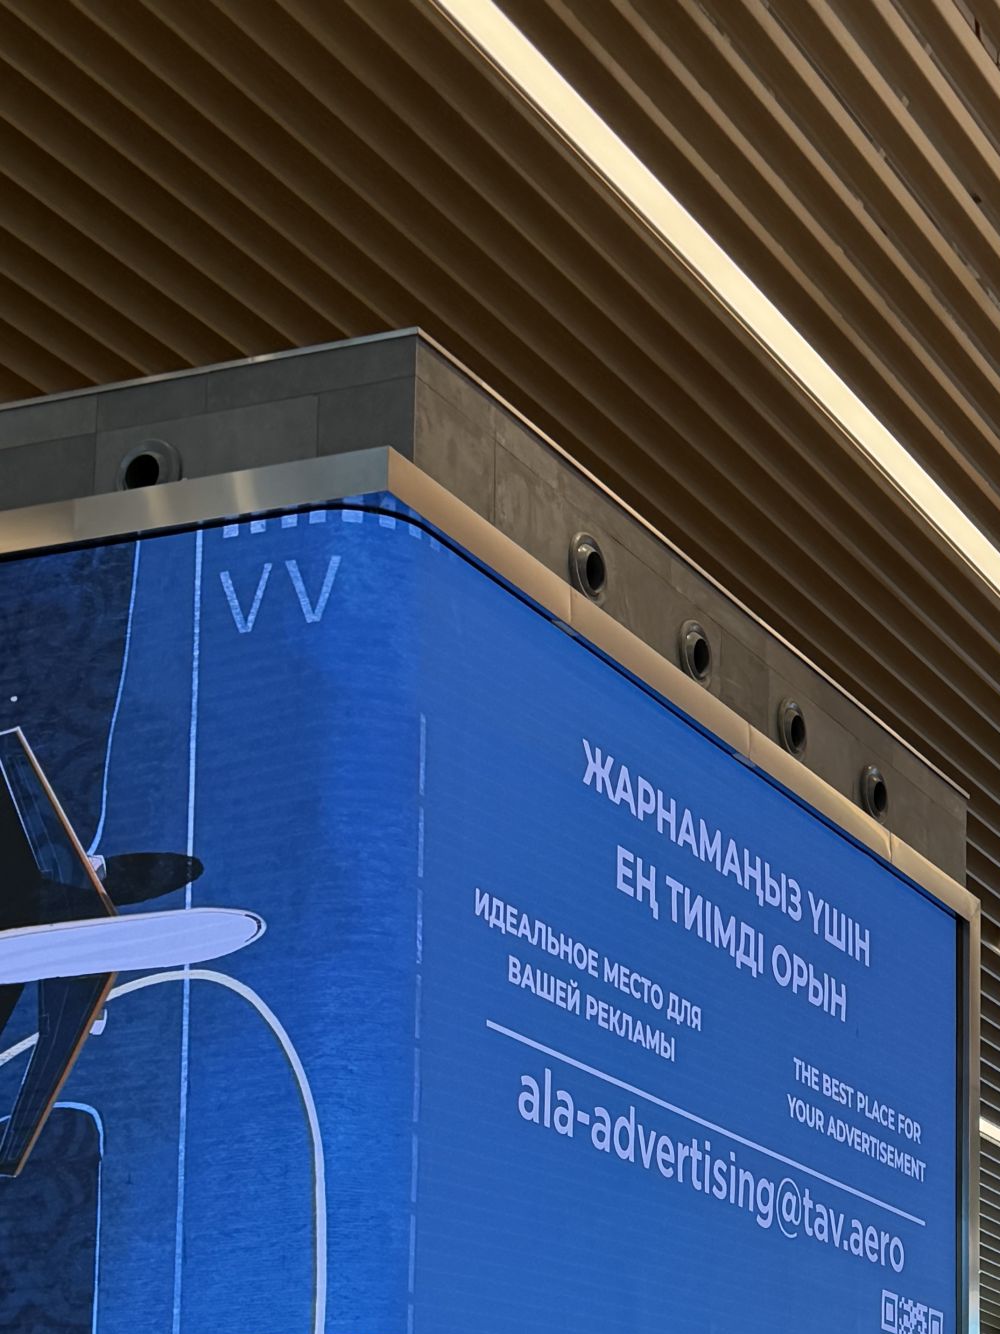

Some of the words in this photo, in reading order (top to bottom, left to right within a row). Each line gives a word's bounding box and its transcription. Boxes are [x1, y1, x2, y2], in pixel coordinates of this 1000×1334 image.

[582, 738, 802, 922] ЖАРНАМАҢЫЗ
[807, 890, 870, 968] ҮШІН
[475, 887, 599, 978] ИДЕАЛЬНОЕ
[603, 957, 663, 1010] МЕСТО
[667, 992, 702, 1032] ДЛЯ
[616, 845, 659, 920] ЕҢ
[665, 875, 764, 978] ТИІМДІ
[772, 944, 847, 1023] ОРЫН
[508, 955, 581, 1015] ВАШЕЙ
[585, 994, 675, 1062] РЕКЛАМЫ
[518, 1067, 905, 1273] ala-advertising@tav.aero
[787, 1093, 824, 1133] YOUR
[827, 1115, 926, 1183] ADVERTISEMENT
[793, 1057, 820, 1091] THE
[822, 1073, 854, 1108] BEST
[857, 1091, 895, 1131] PLACE
[898, 1113, 922, 1145] FOR
